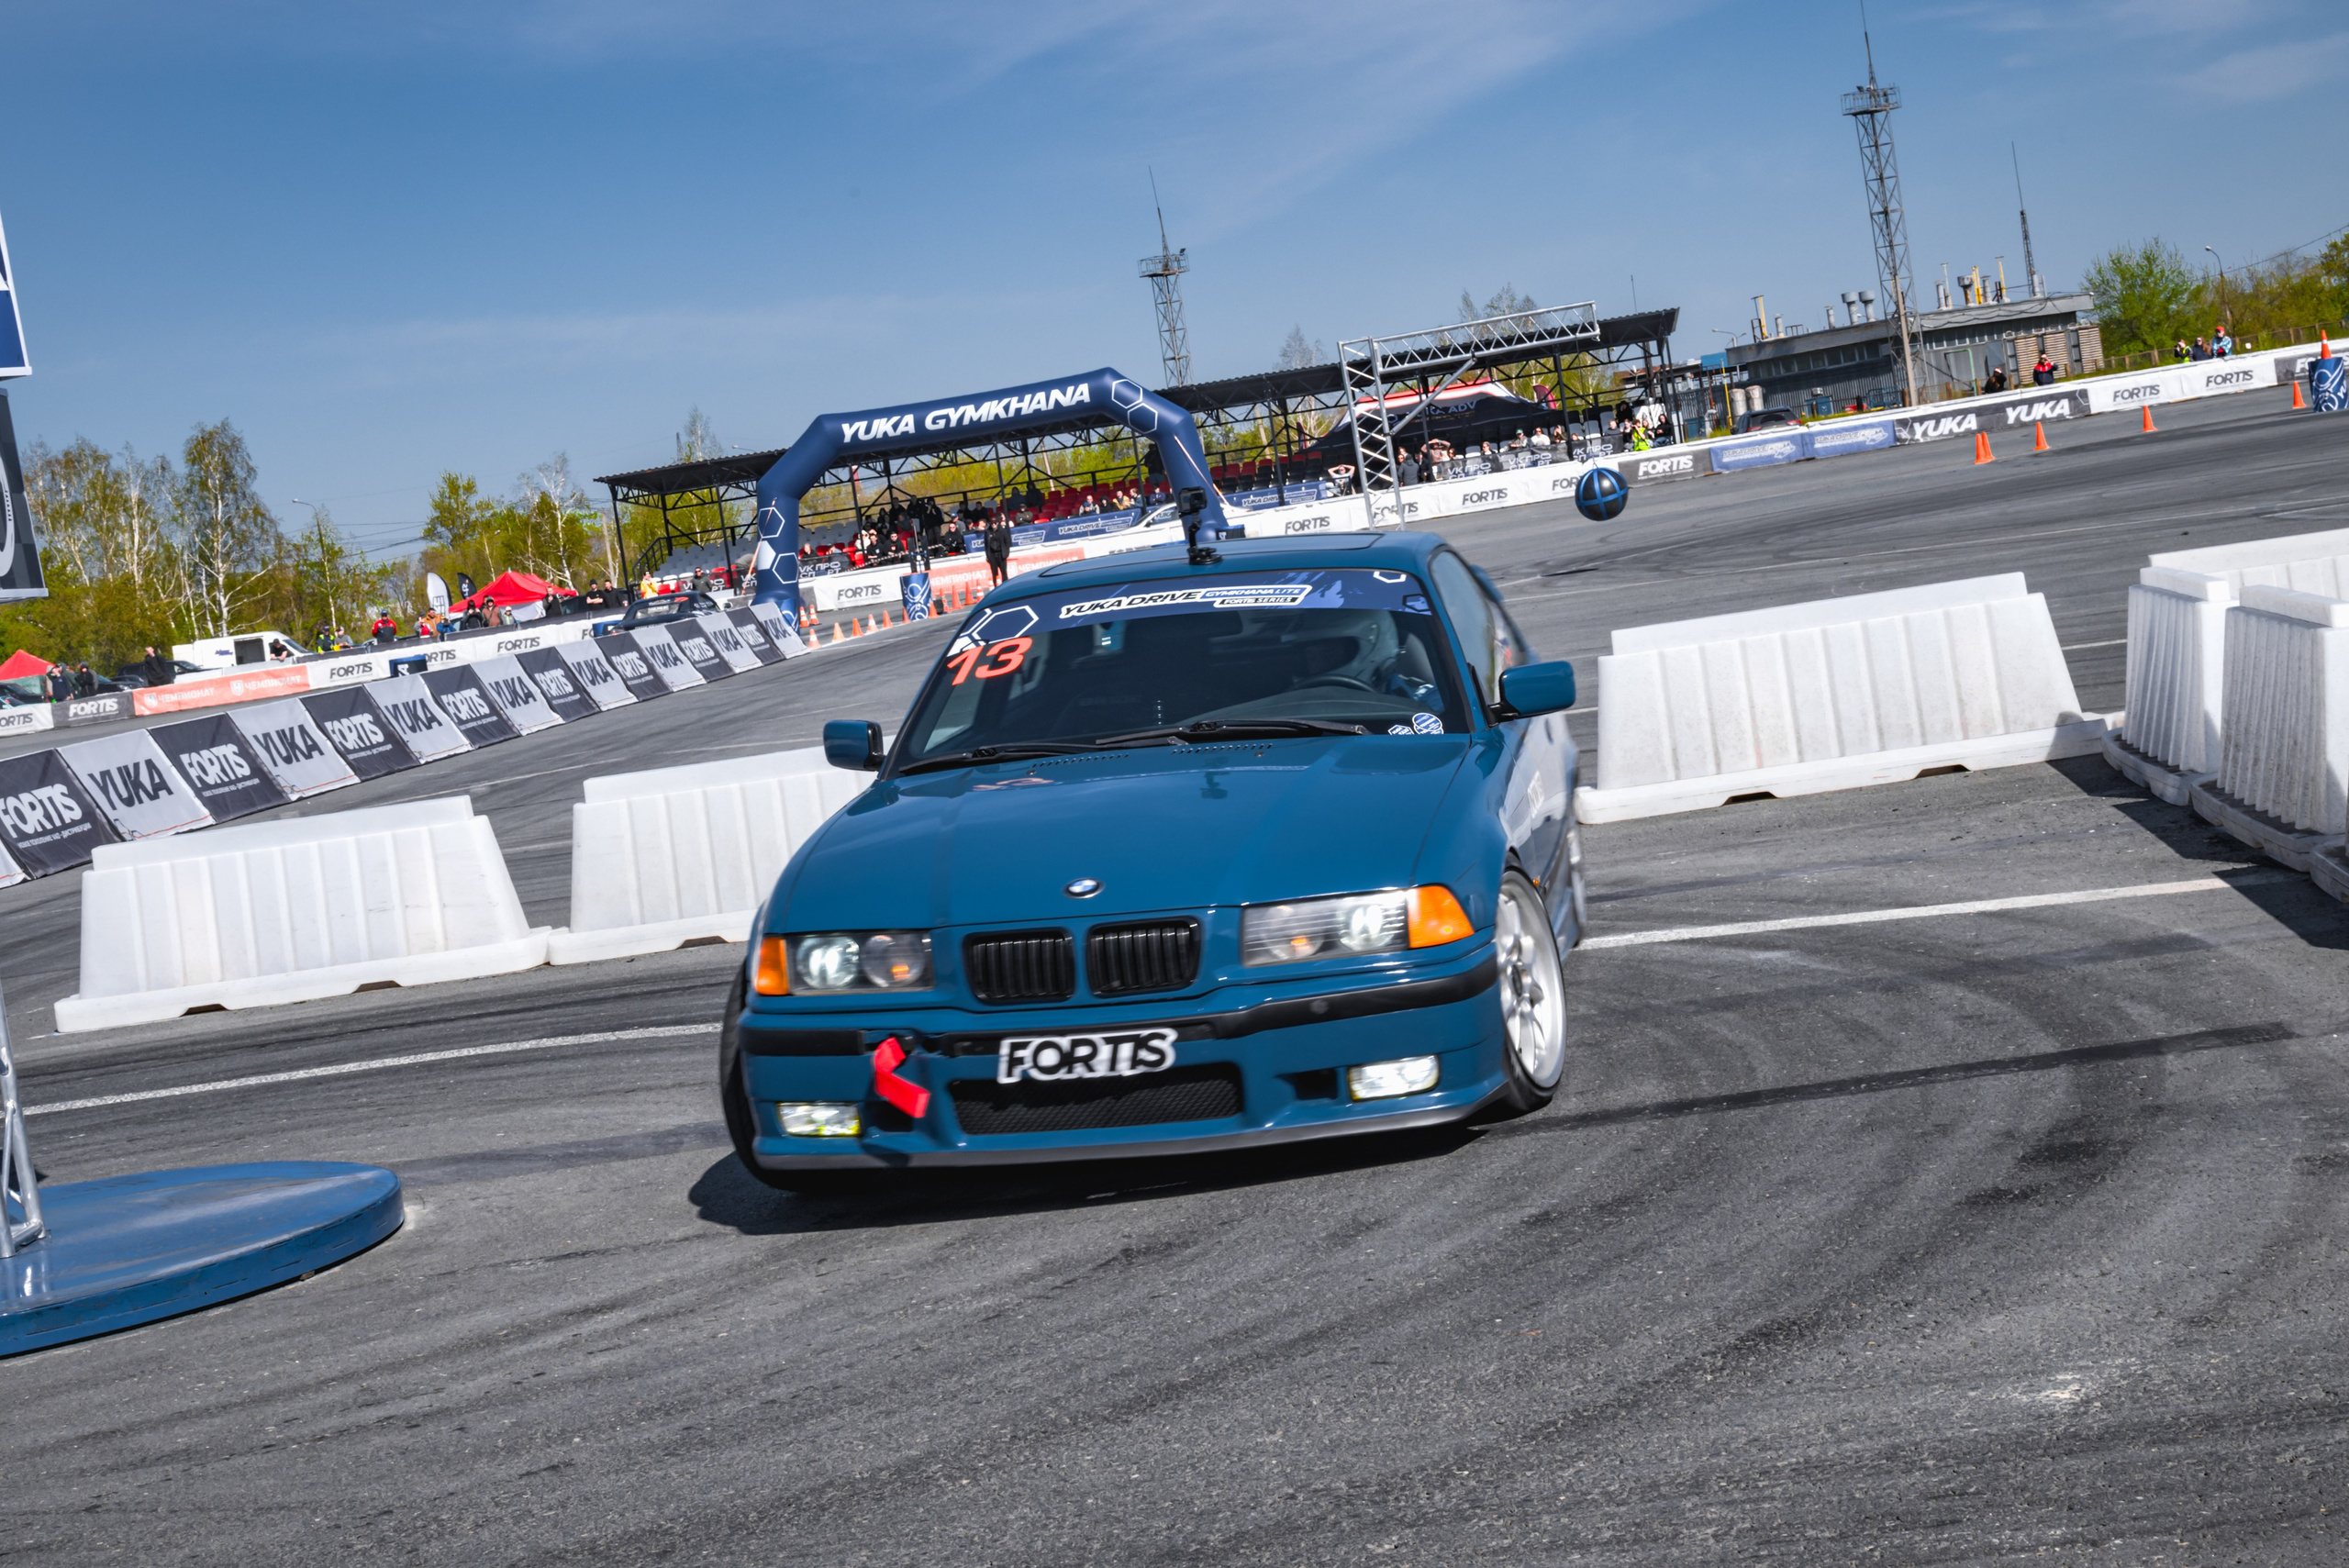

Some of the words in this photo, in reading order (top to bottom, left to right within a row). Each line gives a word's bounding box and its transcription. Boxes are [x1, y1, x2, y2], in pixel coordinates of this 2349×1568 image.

[2206, 370, 2254, 387] FORTIS
[2113, 384, 2160, 402] FORTIS
[841, 414, 916, 443] YUKA
[925, 383, 1091, 430] GYMKHANA
[1448, 401, 1477, 413] ADV
[2006, 398, 2070, 424] YUKA
[1913, 414, 1977, 439] YUKA
[1639, 455, 1693, 476] FORTIS
[1553, 476, 1580, 491] FOR
[1463, 488, 1508, 505] FORTIS
[1079, 522, 1100, 530] DRIVE
[1285, 517, 1330, 534] FORTIS
[838, 584, 882, 600] FORTIS
[1063, 599, 1123, 616] YUKA
[1127, 591, 1201, 606] DRIVE
[425, 650, 456, 662] ORTIS
[497, 637, 540, 652] FORTIS
[645, 642, 684, 670] YUKA
[330, 662, 373, 679] FORTIS
[572, 658, 615, 687] YUKA
[612, 651, 648, 679] FORTIS
[947, 637, 1032, 685] 13
[158, 687, 215, 703] ЧЕМПИОНАТ
[244, 675, 301, 691] ЧЕМПИОНАТ
[488, 675, 537, 709] YUKA
[534, 668, 573, 697] FORTIS
[69, 698, 118, 717] FORTIS
[384, 698, 443, 734] YUKA
[440, 687, 490, 722] FORTIS
[0, 713, 33, 727] ORTIS
[324, 713, 384, 751] FORTIS
[252, 724, 324, 767] YUKA
[180, 743, 250, 788] FORTIS
[87, 759, 174, 811] YUKA
[0, 784, 83, 839] FORTIS
[1002, 1029, 1174, 1081] FORTIS
